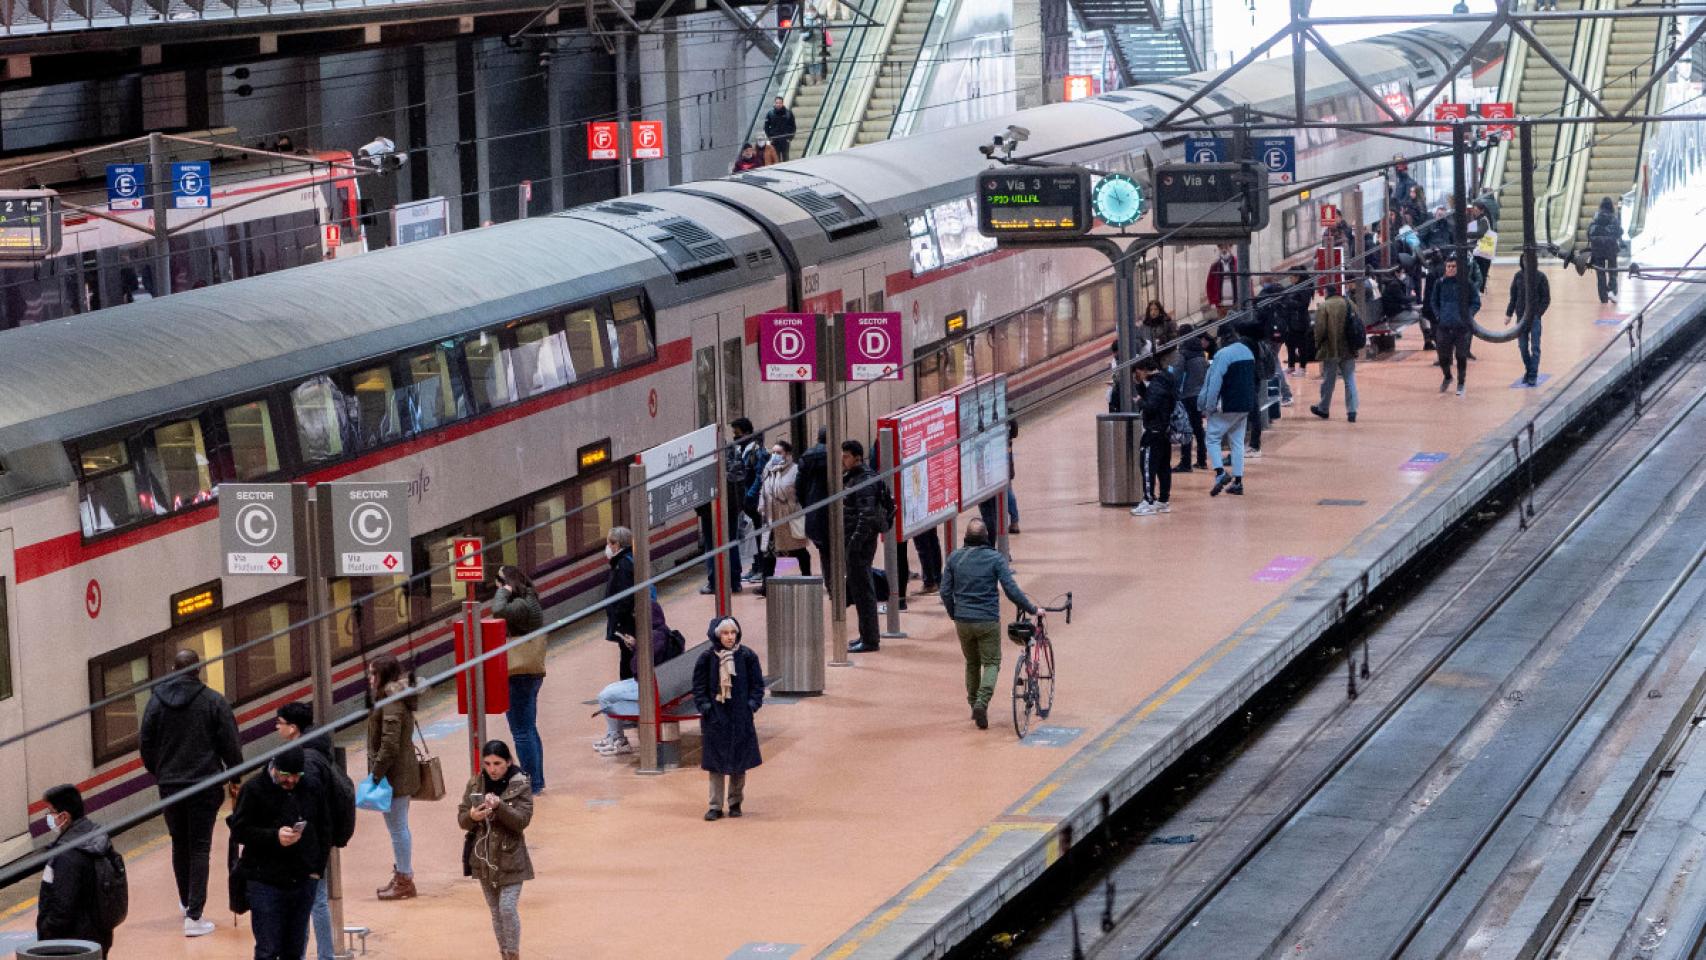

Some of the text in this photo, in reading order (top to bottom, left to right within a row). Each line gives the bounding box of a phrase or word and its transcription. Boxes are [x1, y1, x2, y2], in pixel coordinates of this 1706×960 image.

[600, 133, 608, 146] F
[644, 132, 654, 144] F
[1270, 152, 1280, 167] E
[120, 178, 132, 192] E
[1032, 179, 1040, 190] 3
[1208, 175, 1216, 186] 4
[6, 202, 14, 212] 2
[782, 332, 800, 354] D
[866, 332, 884, 354] D
[236, 492, 274, 500] SECTOR
[350, 490, 388, 499] SECTOR
[244, 510, 268, 540] C
[358, 508, 383, 539] C
[272, 558, 278, 568] 3
[387, 557, 394, 566] 4
